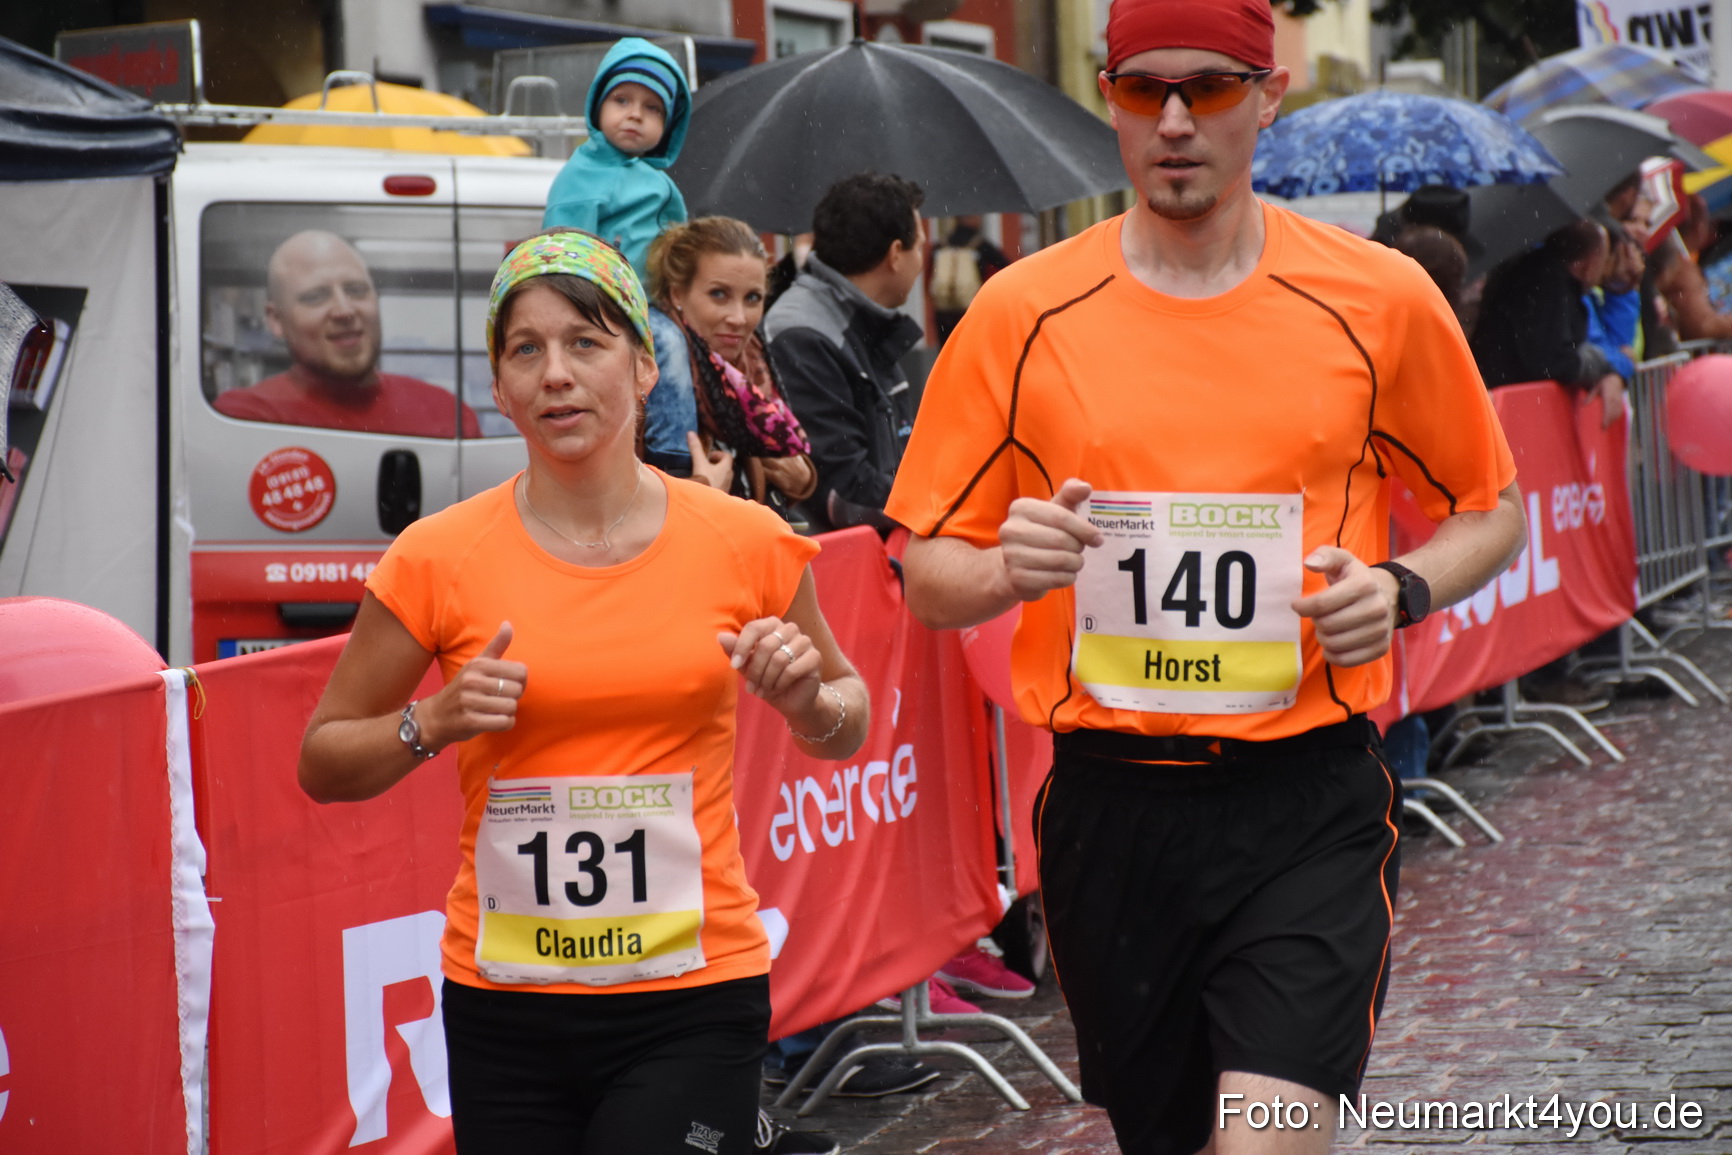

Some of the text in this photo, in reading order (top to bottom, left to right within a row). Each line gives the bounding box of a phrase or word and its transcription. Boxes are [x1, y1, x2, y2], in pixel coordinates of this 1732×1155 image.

[1087, 516, 1155, 531] NeuerMarkt
[1170, 503, 1281, 529] BOCK
[1169, 529, 1283, 540] inspired by smart concepts
[290, 563, 348, 582] 09181
[1118, 548, 1257, 630] 140
[1085, 617, 1093, 630] D
[1144, 650, 1222, 682] Horst
[569, 784, 673, 810] BOCK
[485, 803, 556, 816] NeuerMarkt
[569, 809, 675, 821] inspired by smart concepts
[517, 829, 648, 907] 131
[488, 897, 497, 910] D
[535, 927, 643, 959] Claudia
[690, 1121, 720, 1144] TAO
